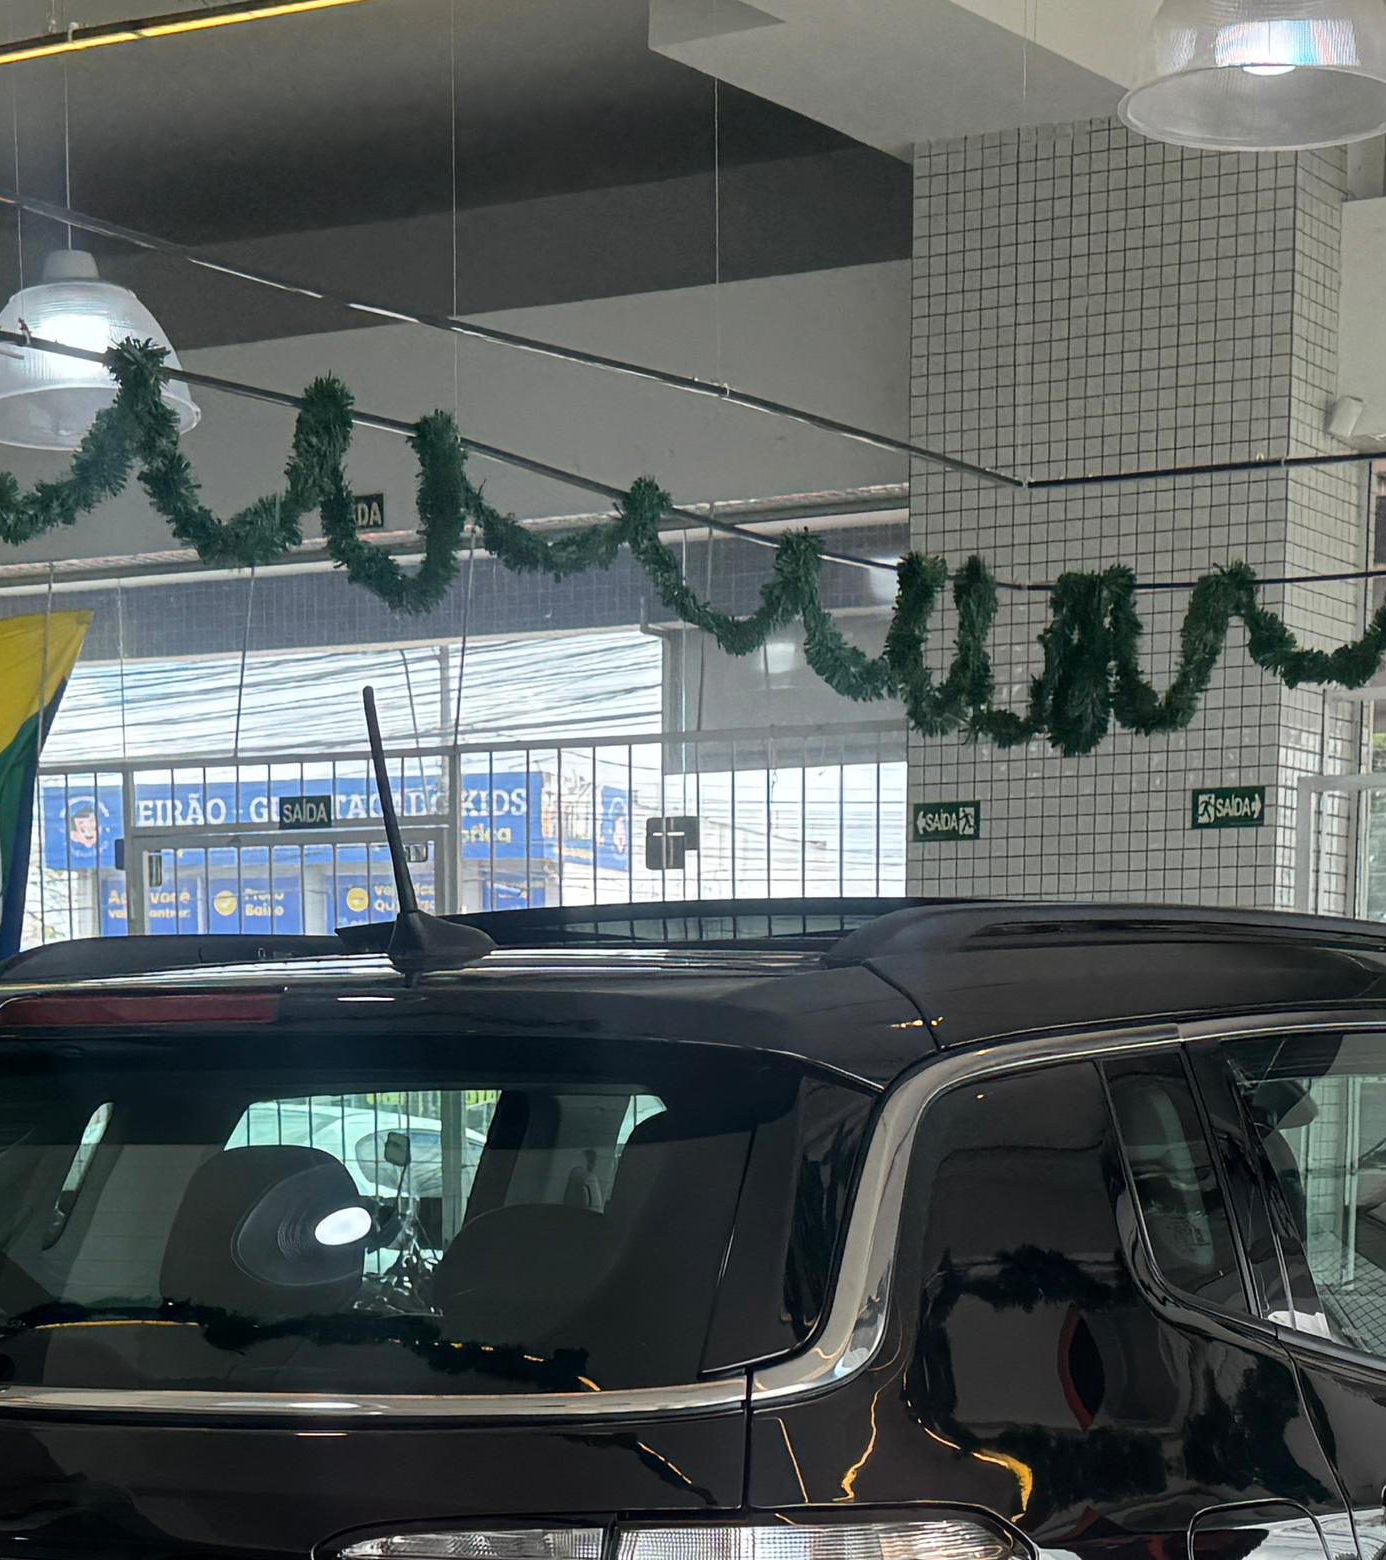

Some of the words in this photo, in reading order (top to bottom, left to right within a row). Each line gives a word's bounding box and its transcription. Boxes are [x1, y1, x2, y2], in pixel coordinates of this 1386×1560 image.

[135, 793, 226, 826] EIRÃO
[460, 788, 526, 816] KIDS
[282, 799, 329, 824] SAÍDA
[1216, 792, 1251, 818] SAÍDA
[925, 809, 958, 832] SAÍDA
